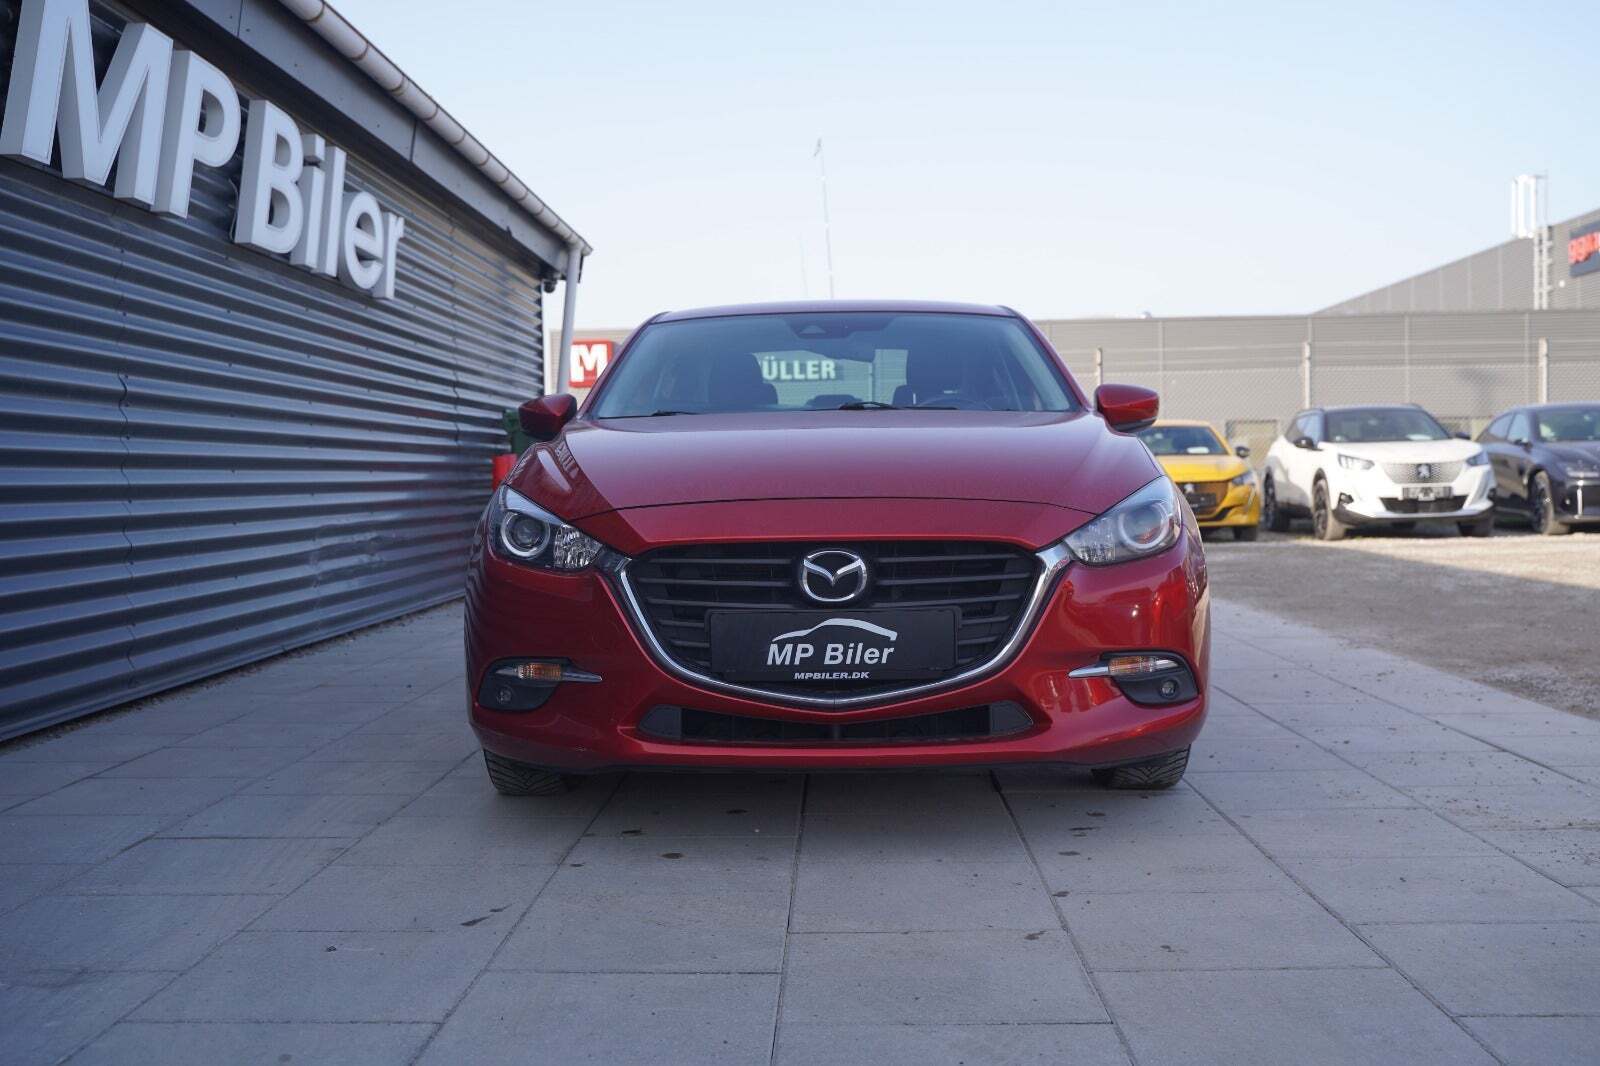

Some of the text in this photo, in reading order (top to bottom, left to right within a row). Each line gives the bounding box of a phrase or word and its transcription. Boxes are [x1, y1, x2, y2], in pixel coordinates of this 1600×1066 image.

[0, 0, 404, 300] MP Biler
[570, 343, 608, 383] M
[758, 356, 836, 380] ÜLLER
[766, 642, 895, 666] MP Biler
[793, 671, 871, 680] MPBILER.DK
